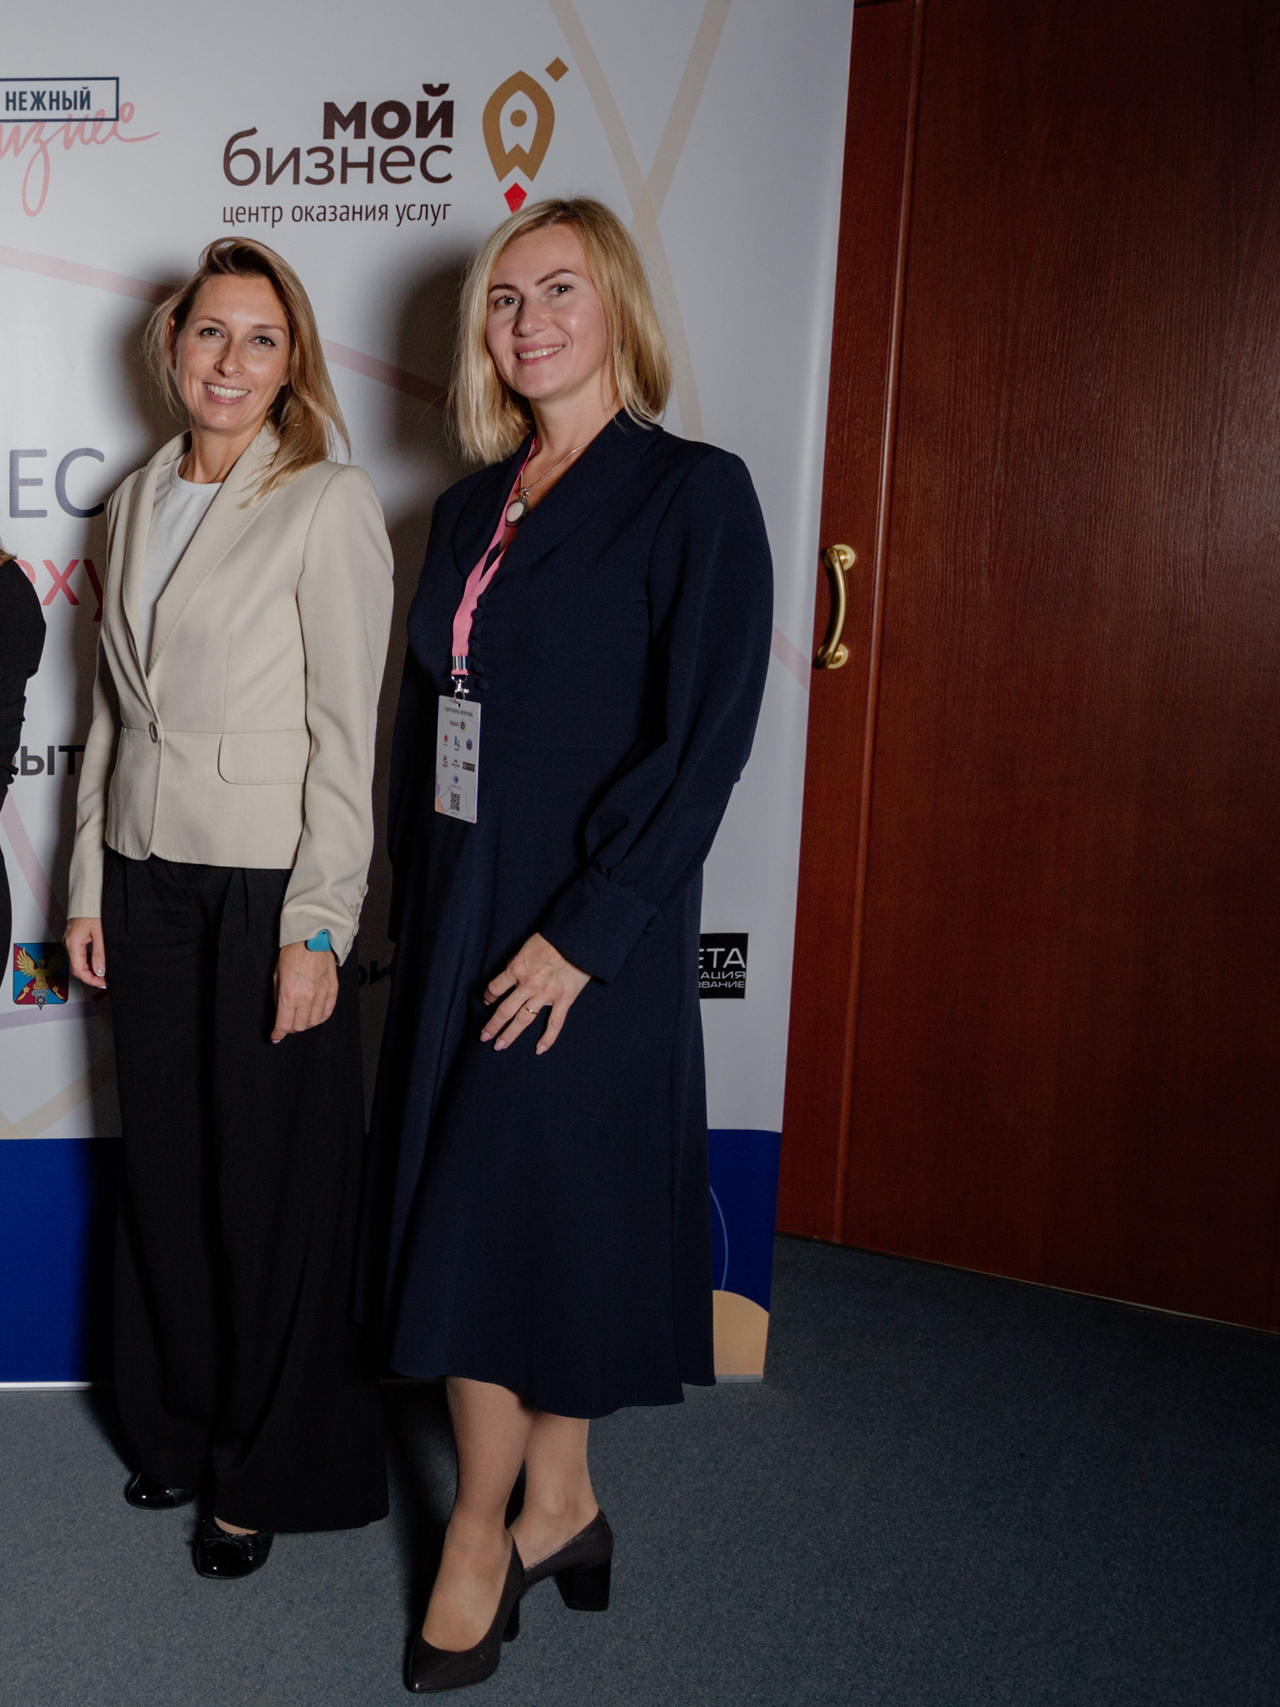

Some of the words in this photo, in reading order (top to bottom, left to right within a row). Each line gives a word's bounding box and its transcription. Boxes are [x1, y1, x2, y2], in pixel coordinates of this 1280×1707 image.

[5, 86, 91, 112] НЕЖНЫЙ
[222, 127, 453, 187] бизнес
[222, 203, 283, 228] центр
[291, 204, 388, 223] оказания
[396, 203, 451, 227] услуг
